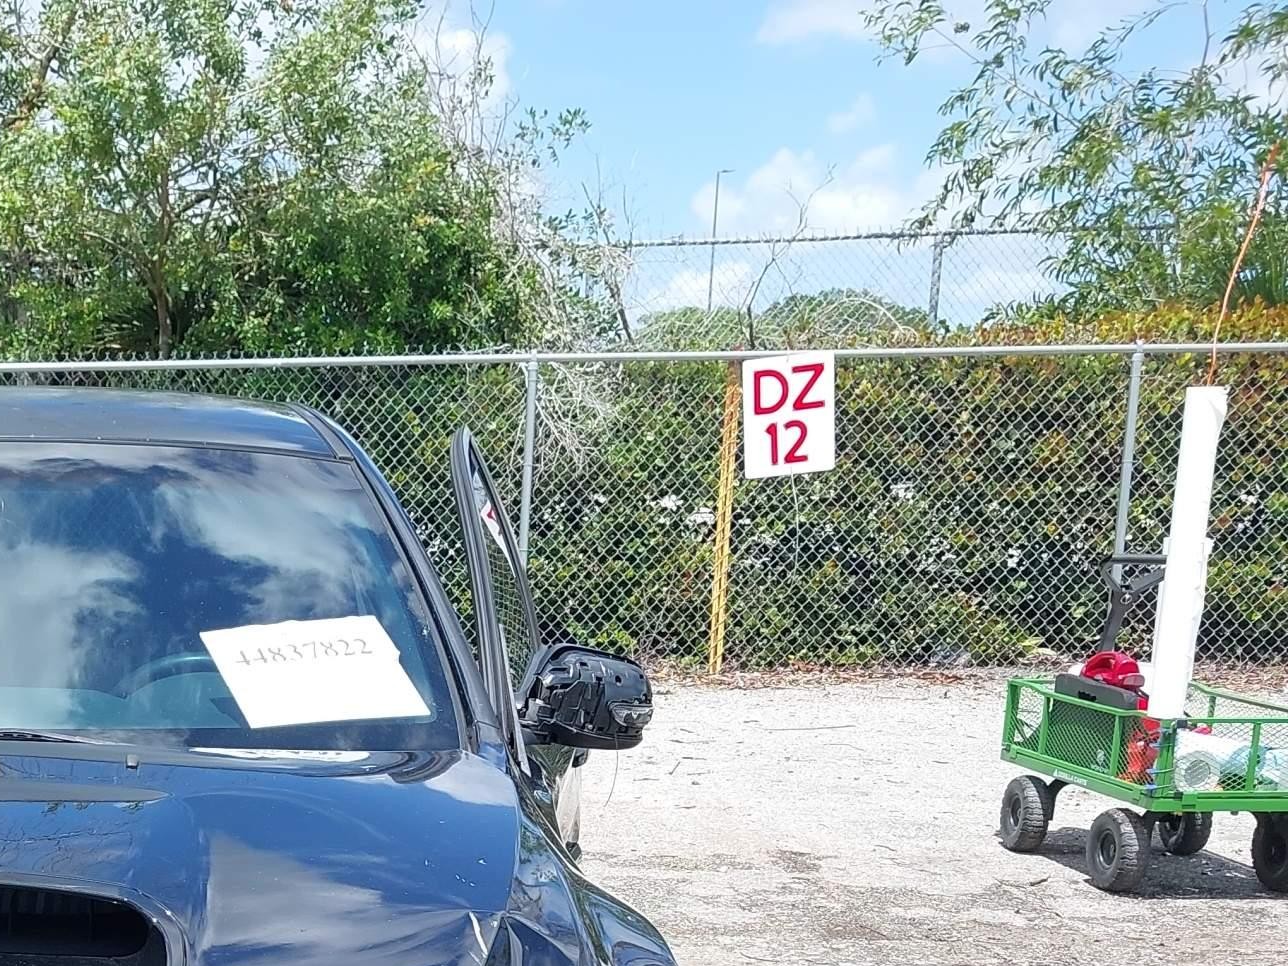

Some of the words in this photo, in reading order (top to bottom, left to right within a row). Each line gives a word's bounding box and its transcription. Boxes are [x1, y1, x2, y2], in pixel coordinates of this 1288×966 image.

[754, 363, 825, 415] DZ
[765, 420, 809, 465] 12
[235, 638, 373, 666] 44837822
